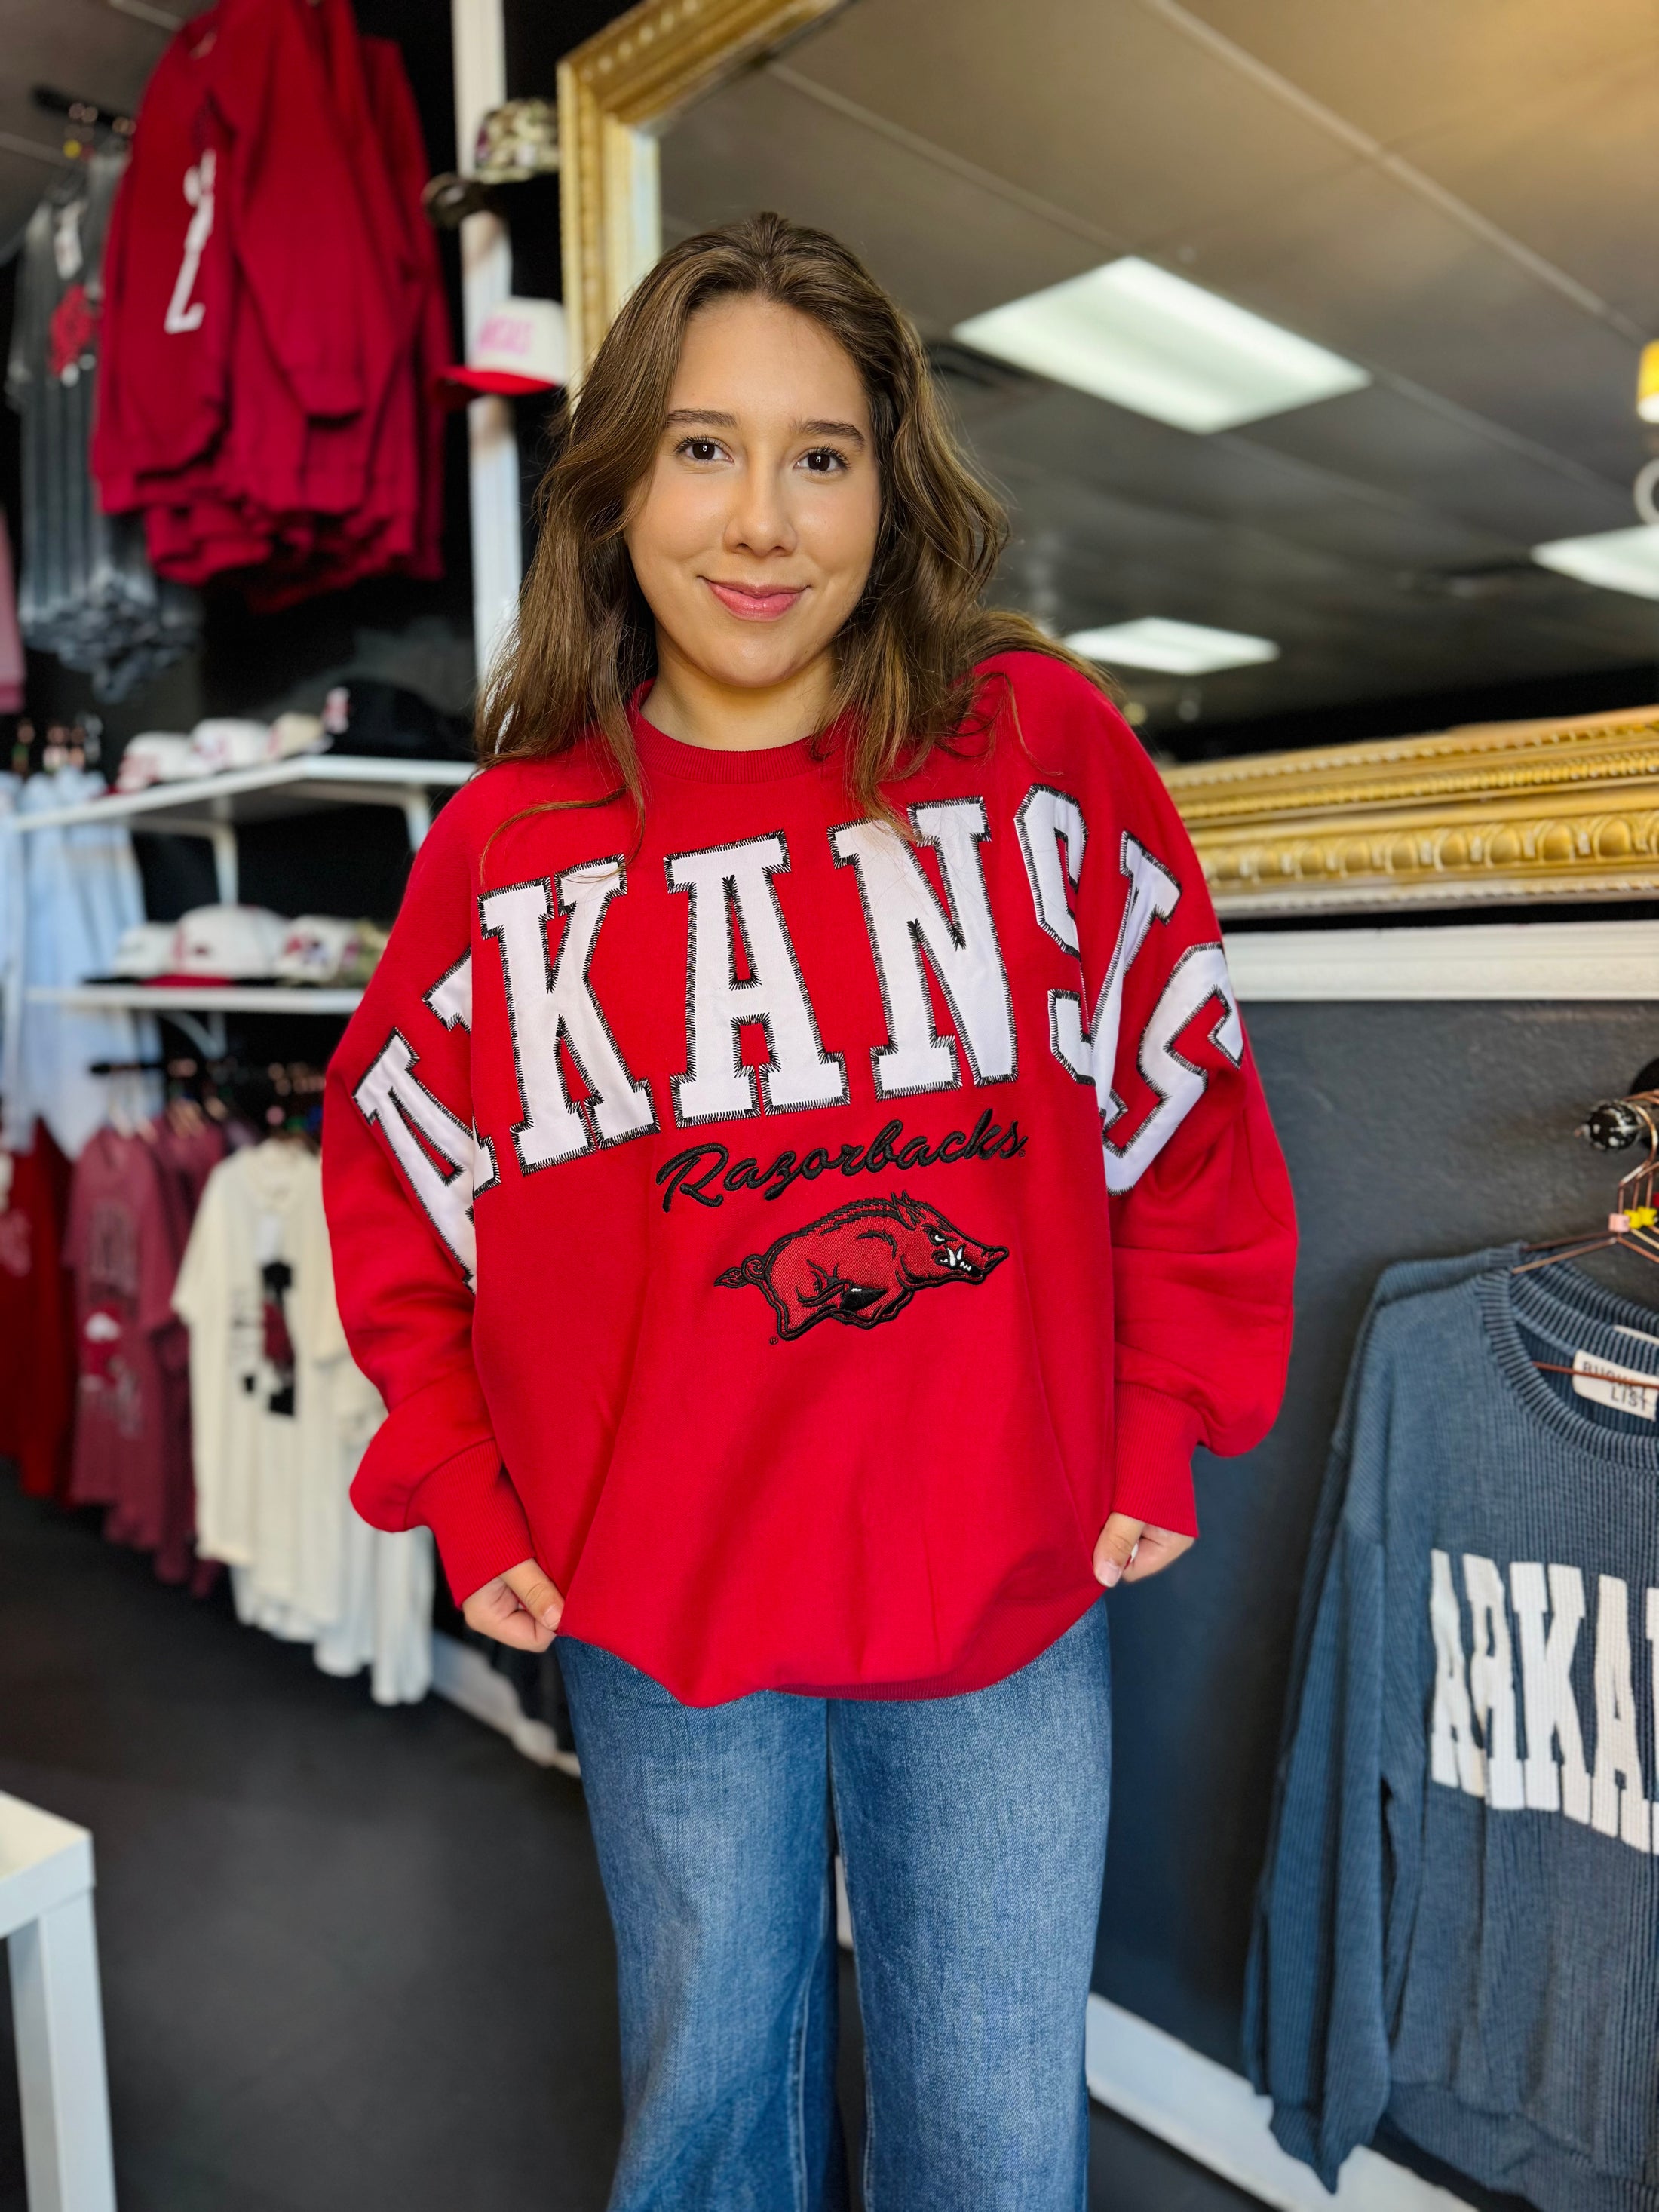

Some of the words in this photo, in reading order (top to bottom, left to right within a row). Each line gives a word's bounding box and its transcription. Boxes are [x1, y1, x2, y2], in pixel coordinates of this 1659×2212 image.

[352, 783, 1244, 1296] AKANSS
[655, 1108, 1029, 1213] Razorbacks
[1611, 1385, 1648, 1410] LIST
[1430, 1548, 1659, 1855] ARKA
